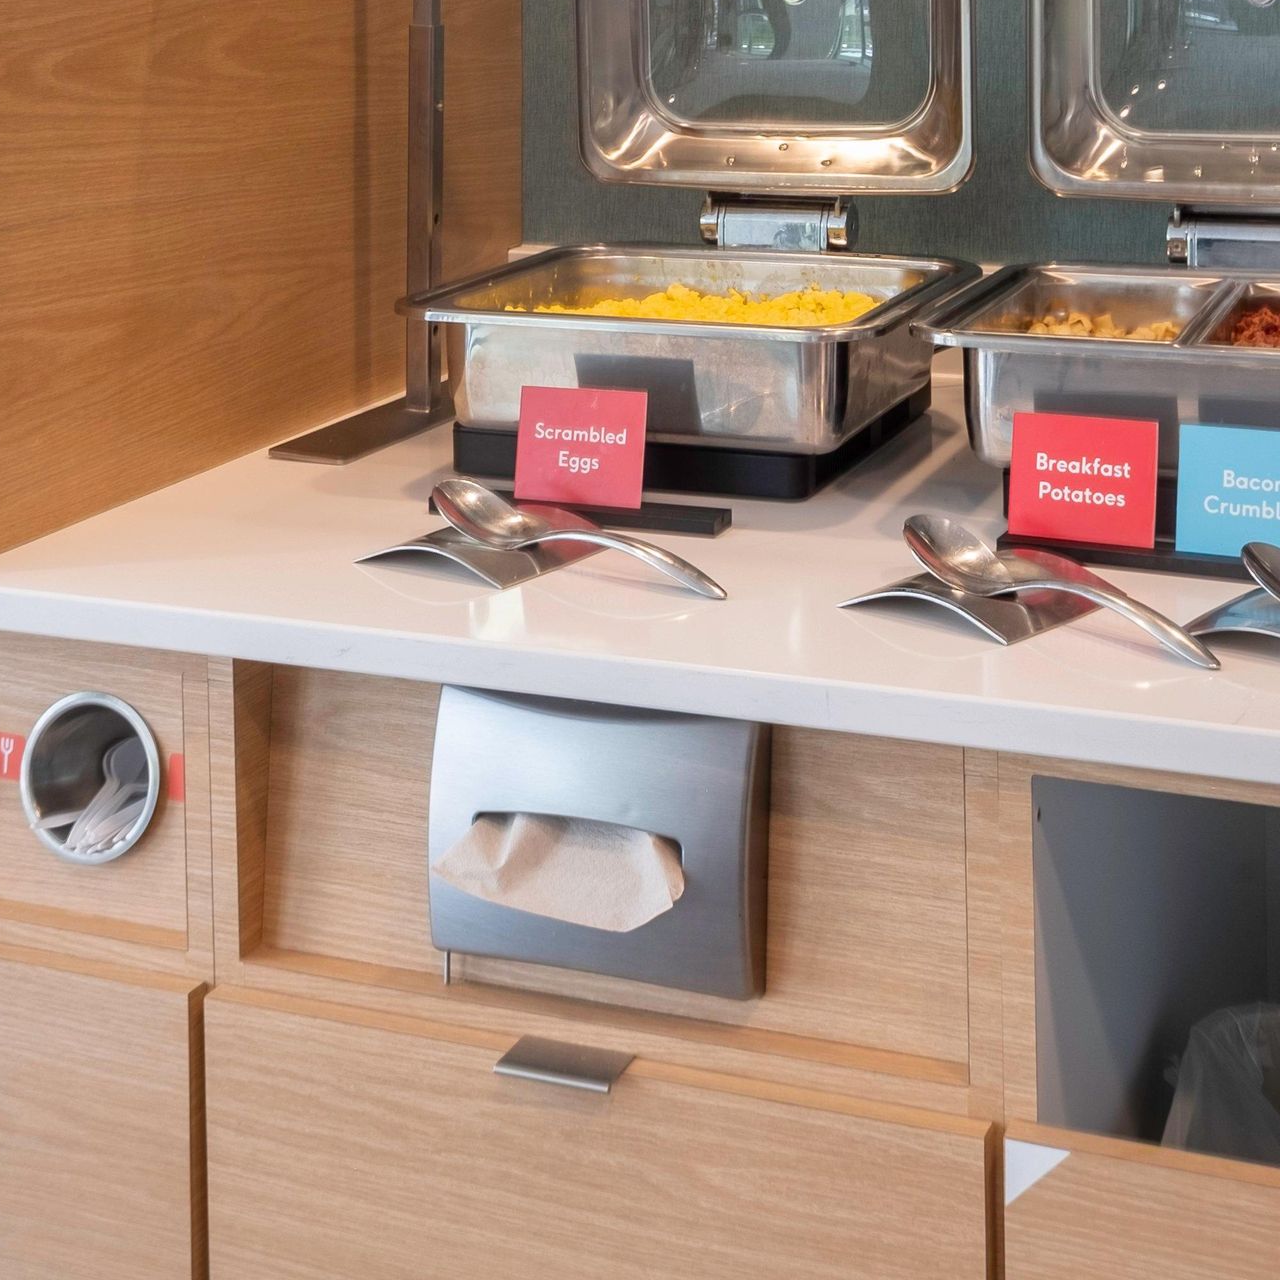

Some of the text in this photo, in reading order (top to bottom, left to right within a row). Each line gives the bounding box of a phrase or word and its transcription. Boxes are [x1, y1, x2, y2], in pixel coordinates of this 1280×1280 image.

[535, 422, 627, 445] Scrambled
[558, 450, 600, 474] Eggs
[1036, 452, 1131, 478] Breakfast
[1038, 481, 1126, 507] Potatoes
